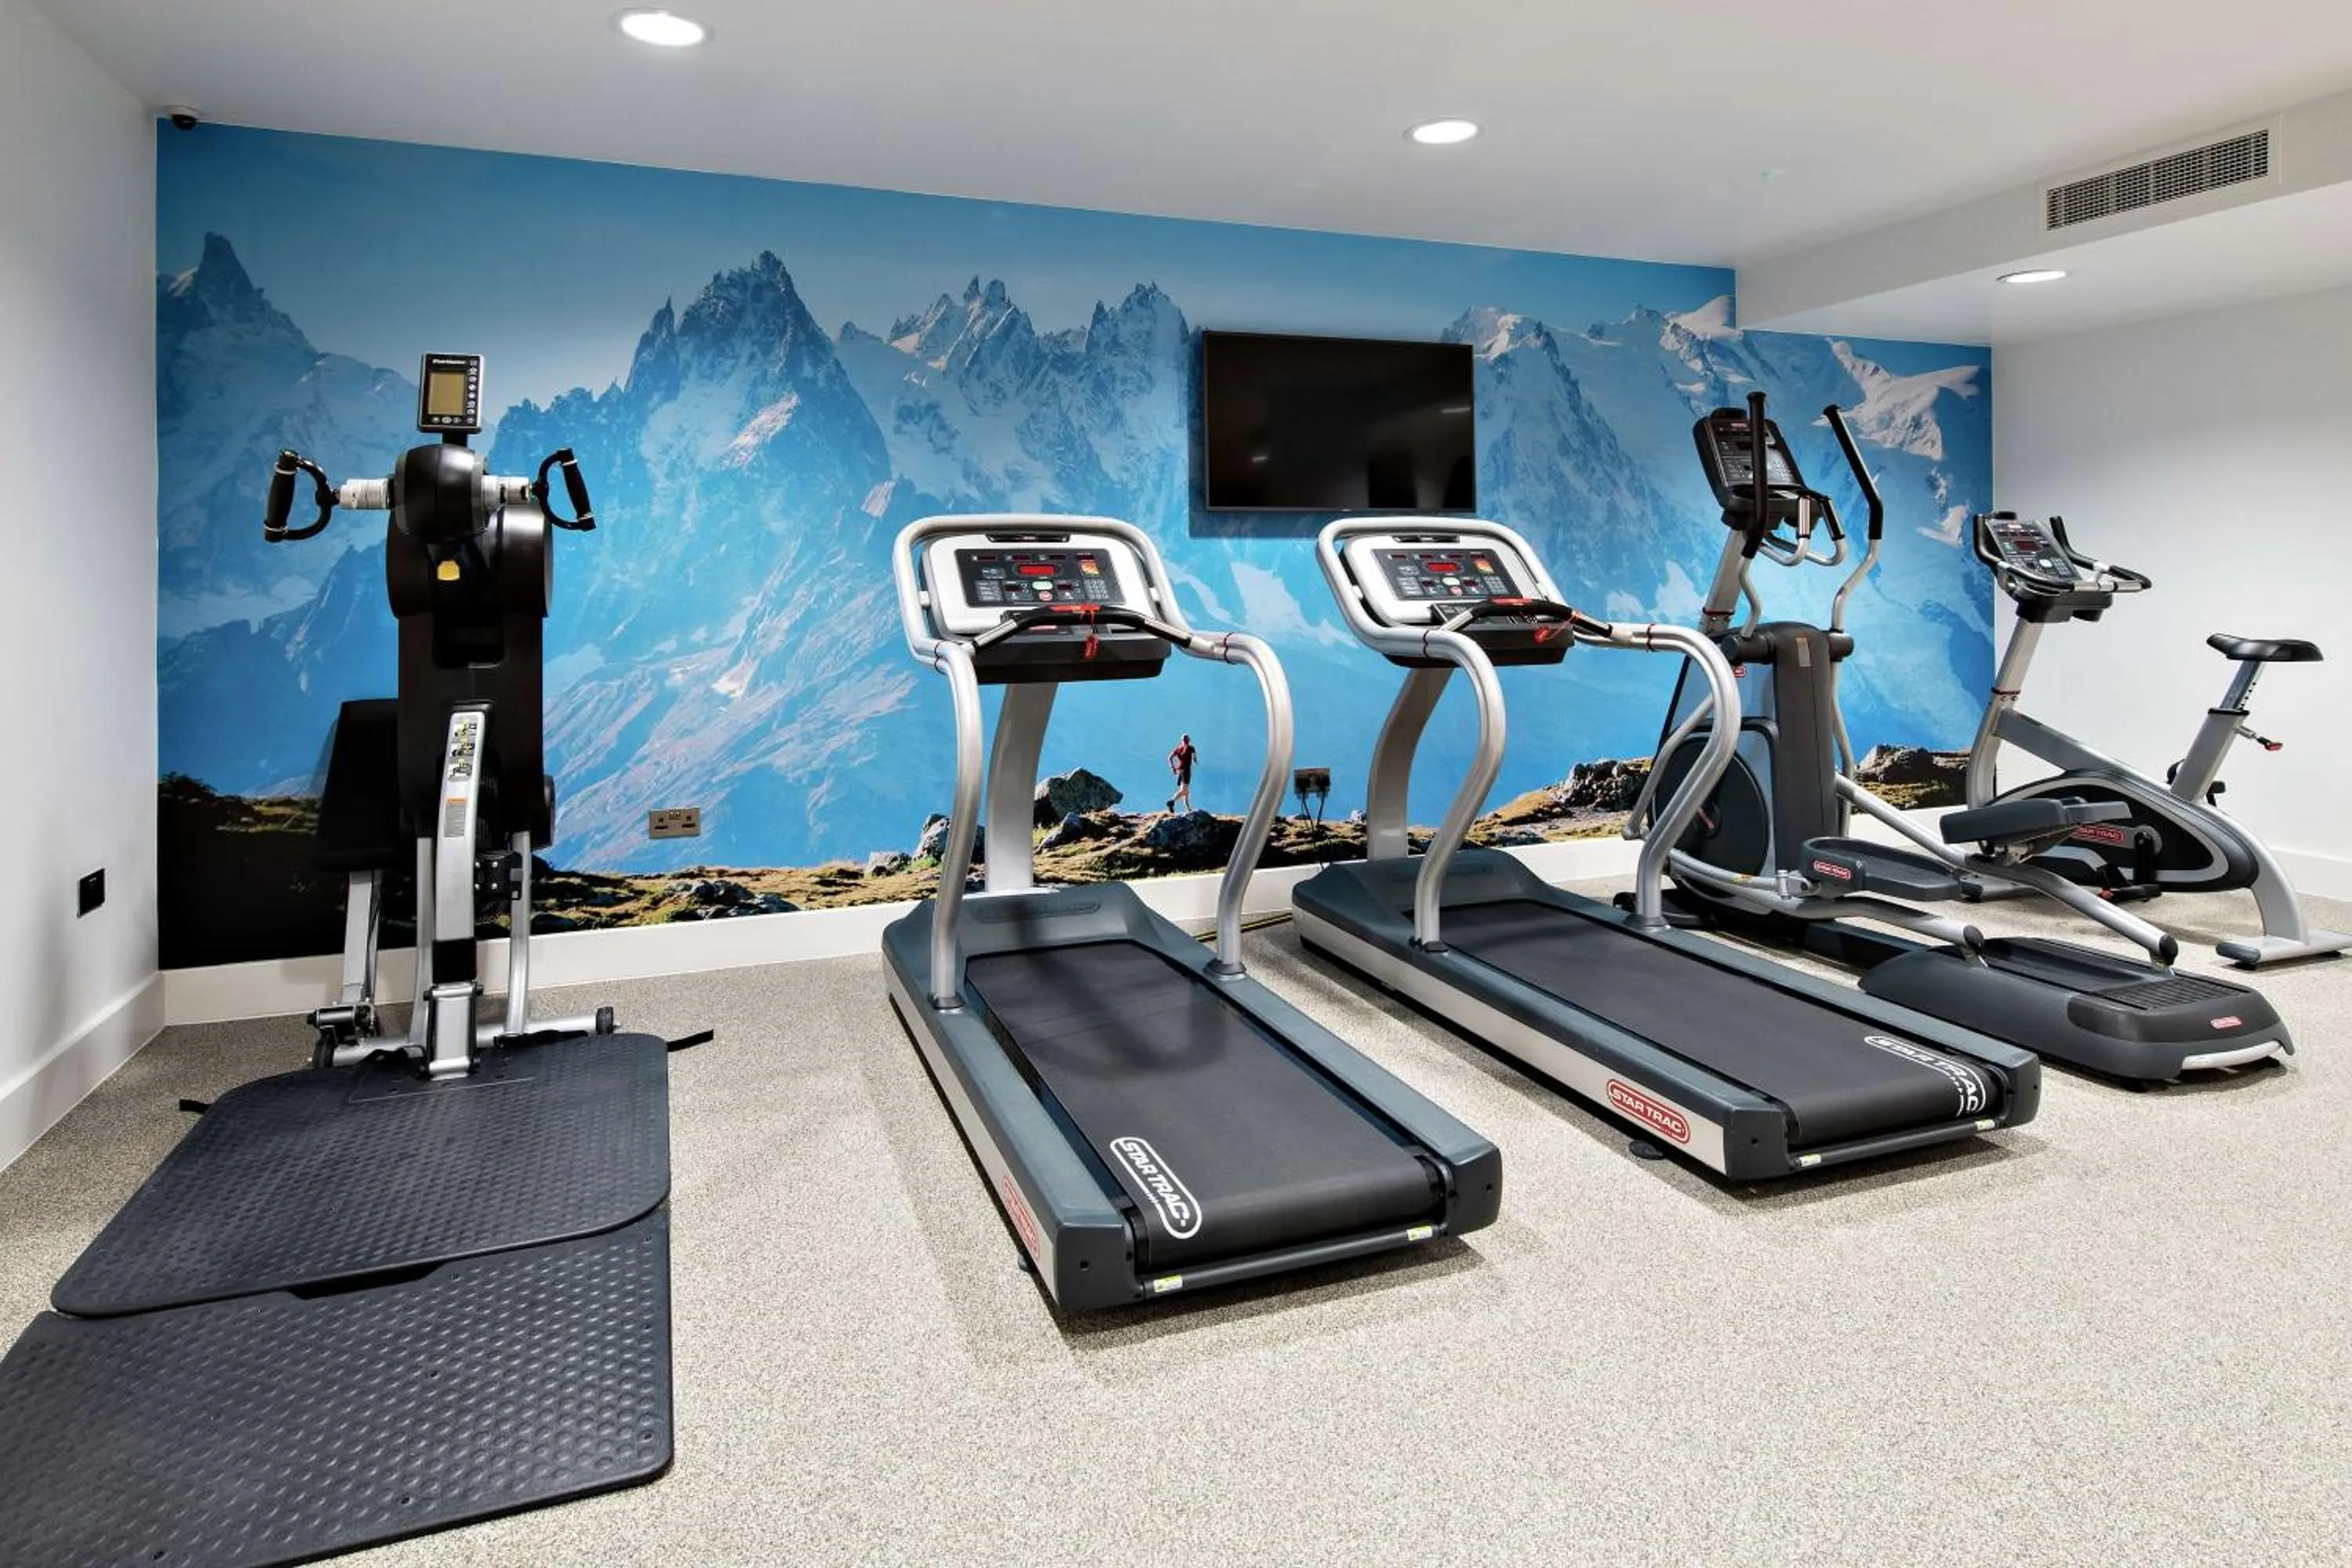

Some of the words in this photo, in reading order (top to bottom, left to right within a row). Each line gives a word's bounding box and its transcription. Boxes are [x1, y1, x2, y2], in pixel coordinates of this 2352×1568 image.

[1612, 1089, 1645, 1114] STAR
[1646, 1105, 1682, 1134] TRAC
[1118, 1141, 1158, 1175] STAR
[1148, 1174, 1190, 1219] TRAC
